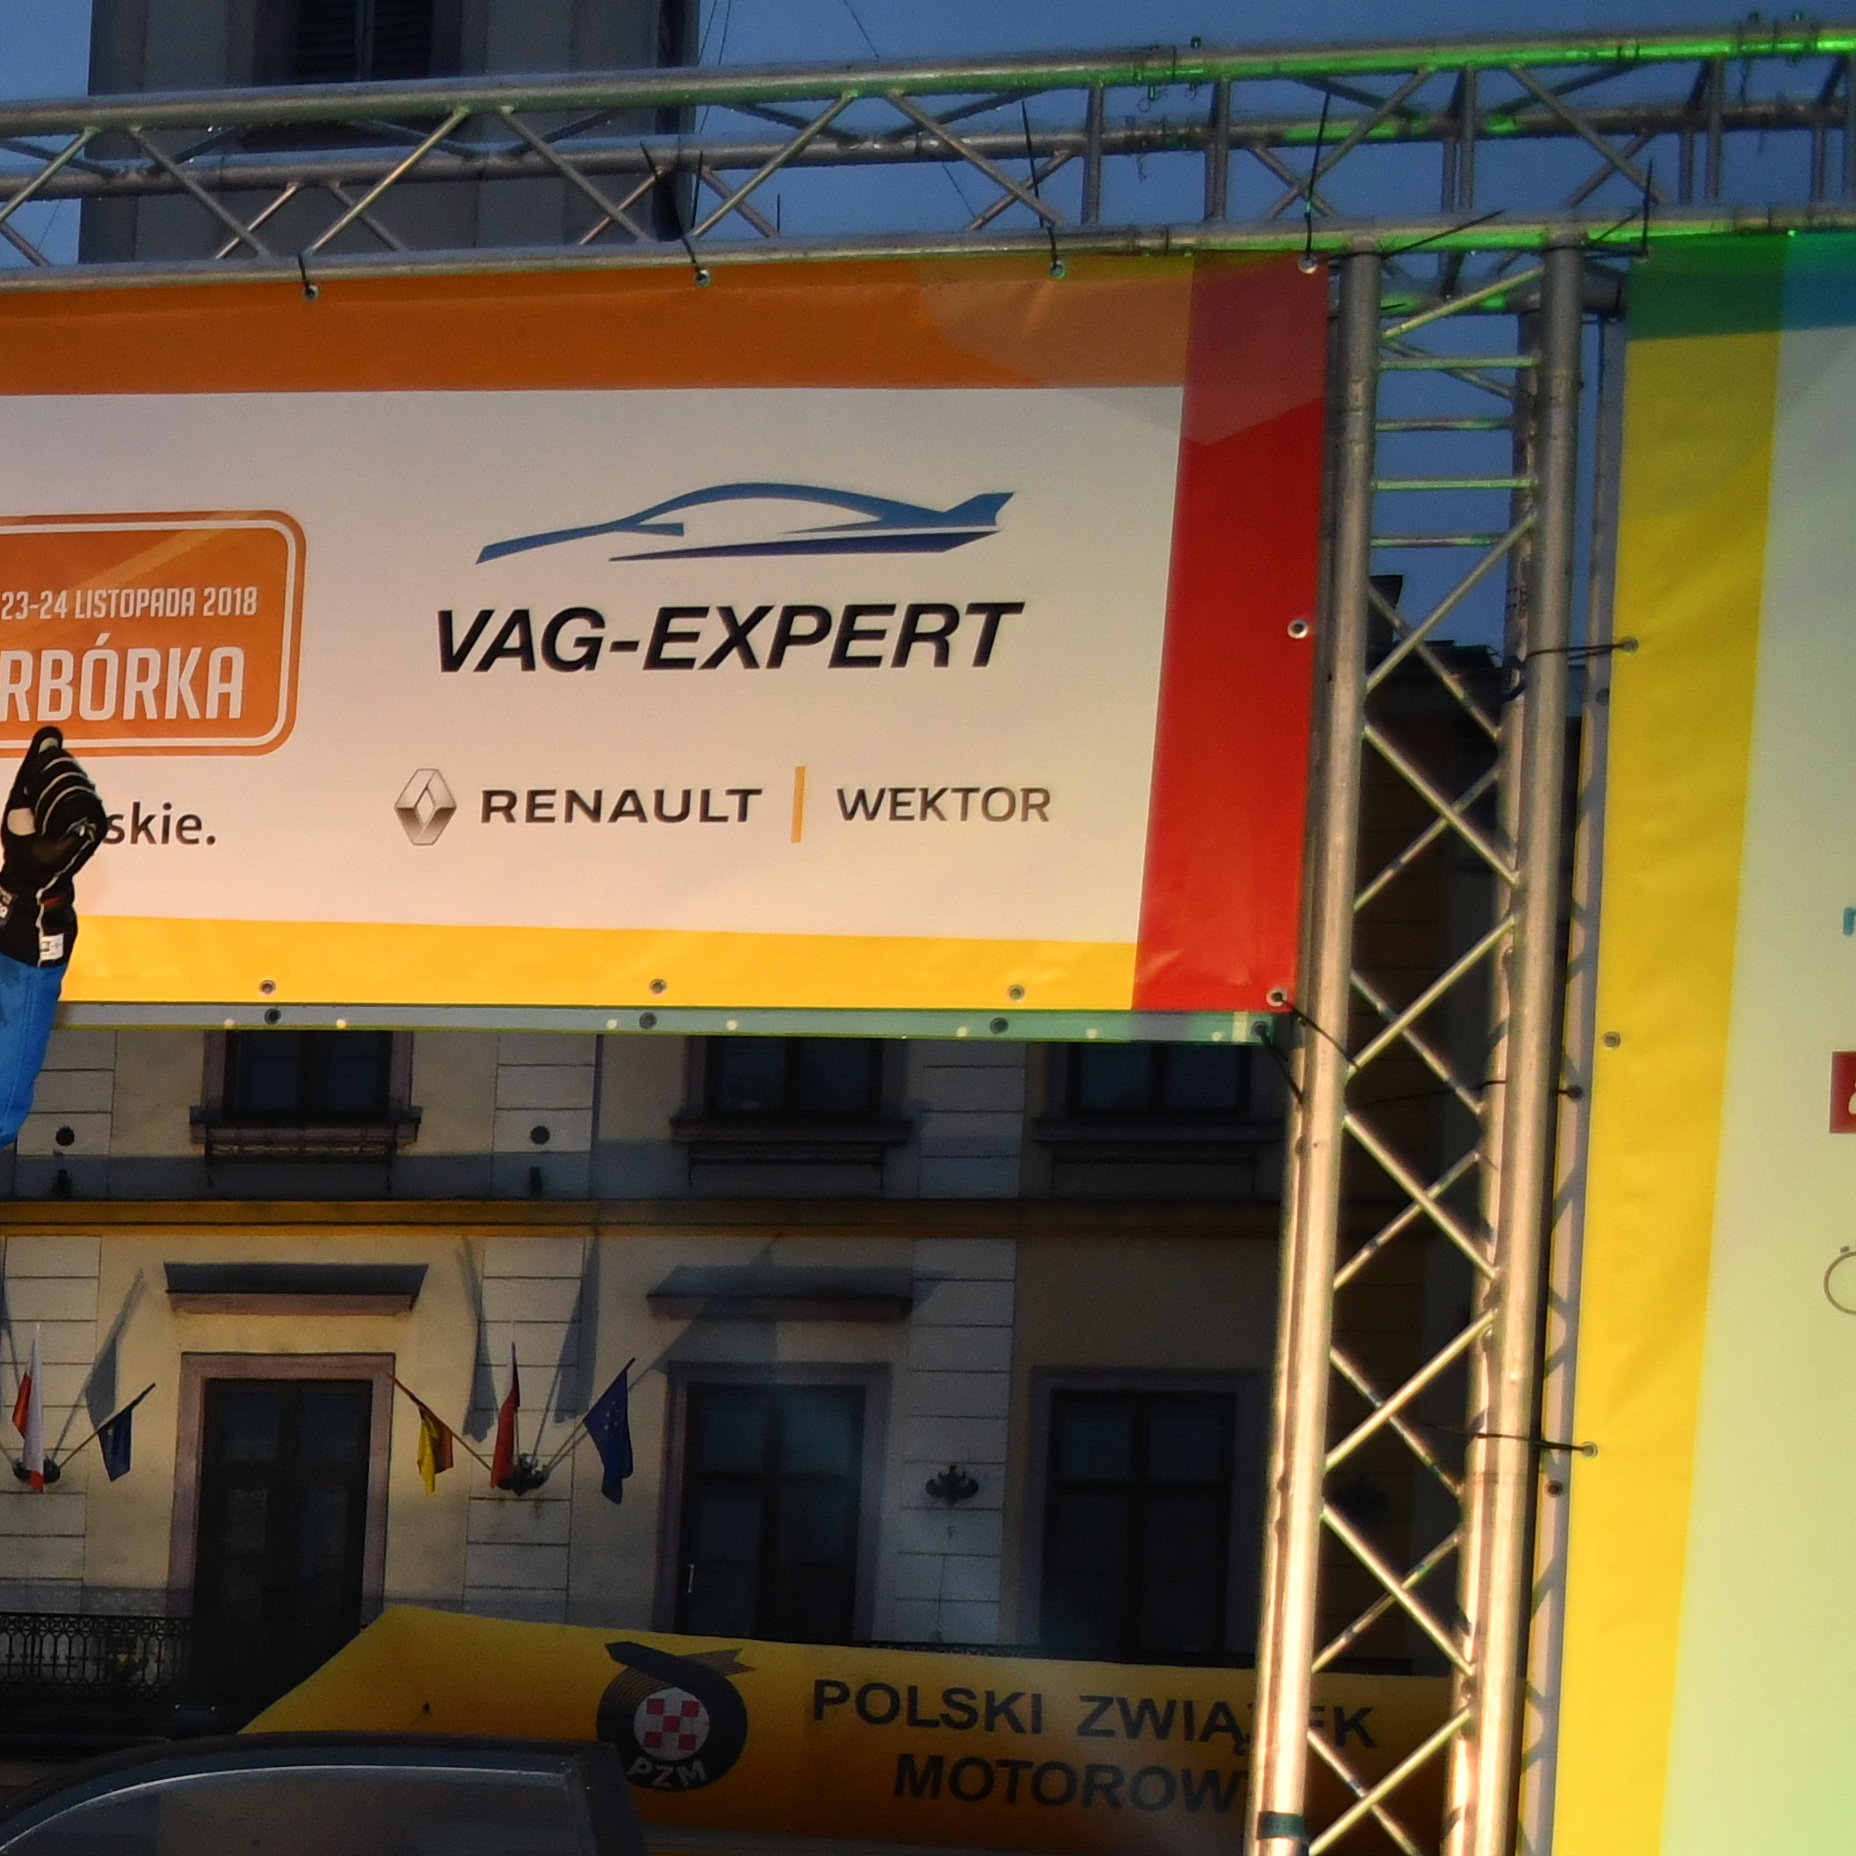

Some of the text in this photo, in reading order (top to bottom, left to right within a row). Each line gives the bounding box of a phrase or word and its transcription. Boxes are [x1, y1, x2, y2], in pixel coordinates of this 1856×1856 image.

[1, 590, 68, 621] 23-24
[75, 588, 194, 619] LISTOPADA
[203, 586, 258, 617] 2018
[436, 601, 1026, 673] VAG-EXPERT
[107, 801, 217, 846] skie.
[480, 786, 1052, 823] RENAULT WEKTOR
[812, 1679, 1377, 1757] POLSKI ZWIĄK
[625, 1754, 708, 1789] PZM
[893, 1752, 1252, 1815] MOTOROW
